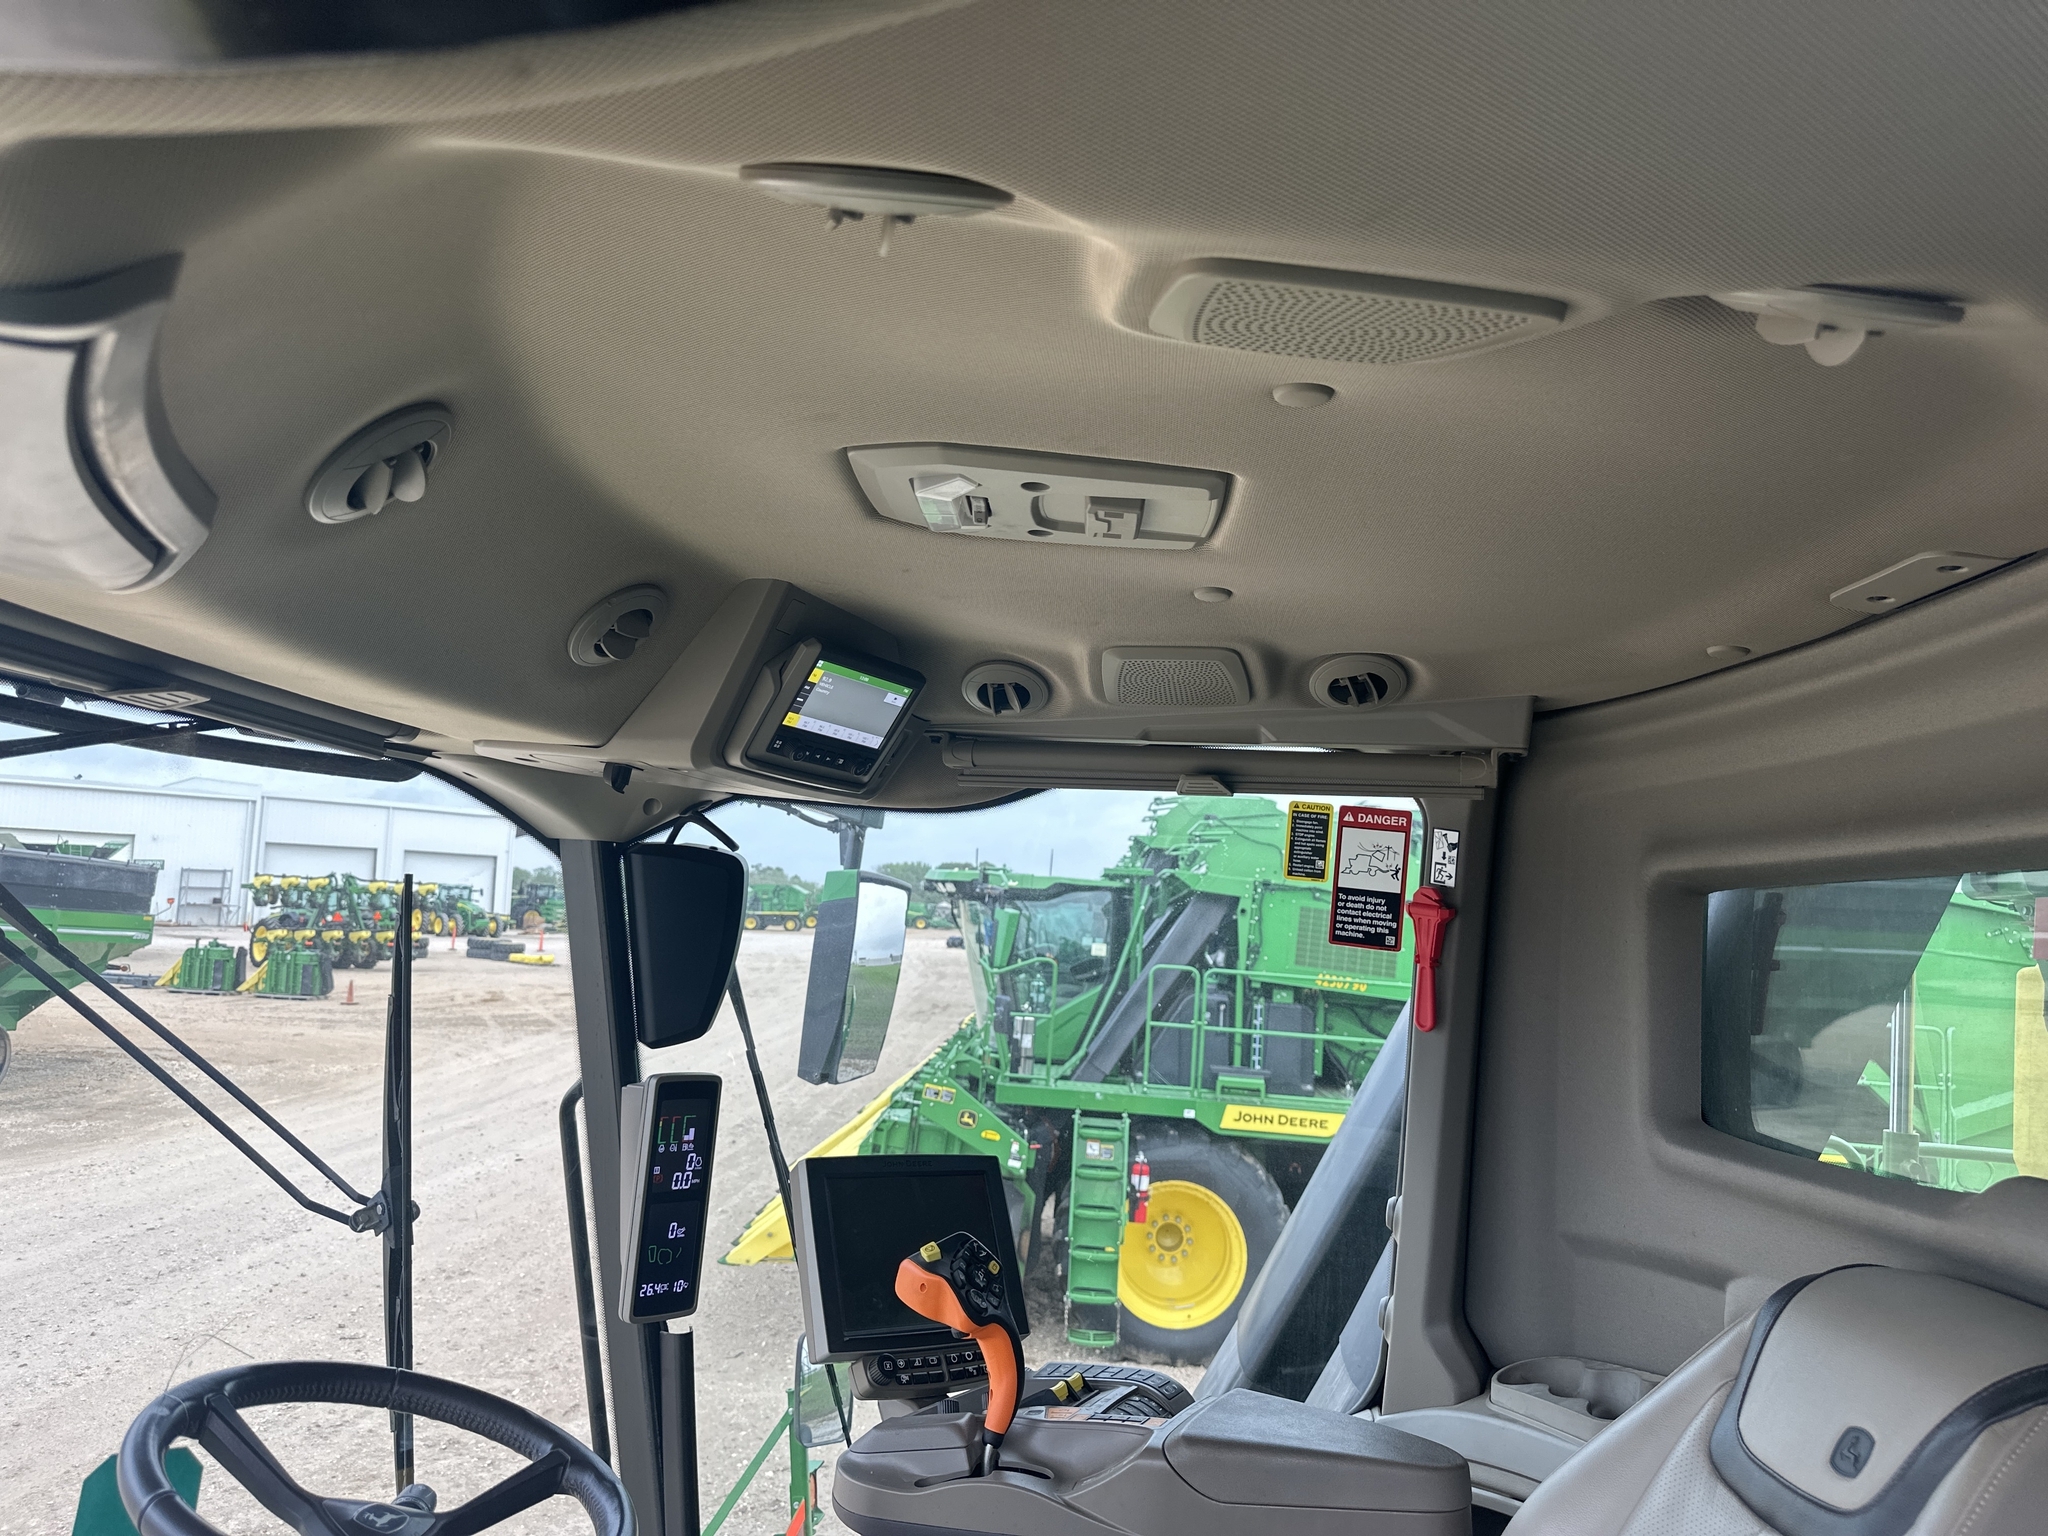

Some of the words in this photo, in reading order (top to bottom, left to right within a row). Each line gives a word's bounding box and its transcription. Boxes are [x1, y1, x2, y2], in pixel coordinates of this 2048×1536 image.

[1358, 814, 1407, 826] DANGER
[1366, 896, 1385, 905] injury
[1362, 911, 1392, 919] electrical
[1344, 924, 1375, 933] operating
[1372, 920, 1397, 928] moving
[1335, 930, 1365, 938] machine.
[1233, 1110, 1274, 1124] JOHN
[1278, 1114, 1329, 1129] DEERE
[671, 1171, 692, 1190] 0.0
[673, 1280, 684, 1292] 10
